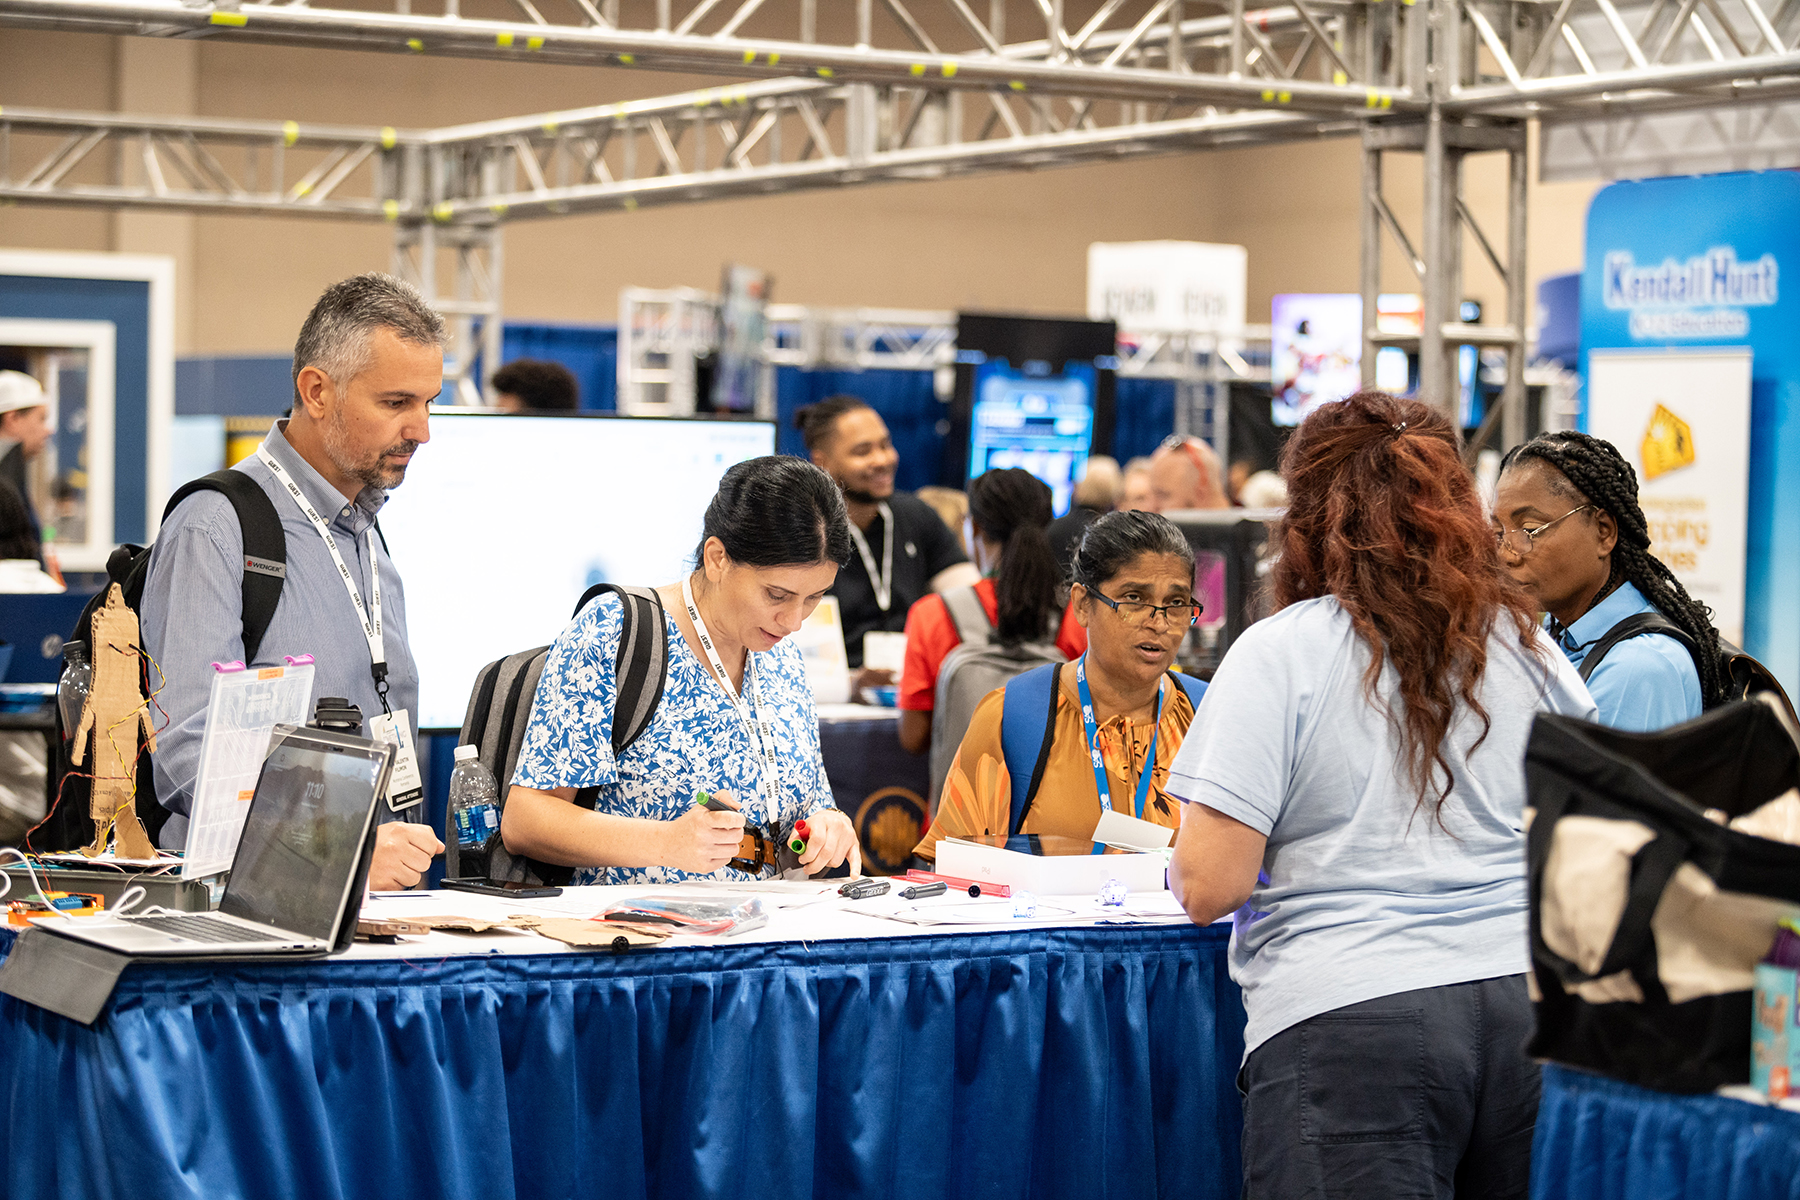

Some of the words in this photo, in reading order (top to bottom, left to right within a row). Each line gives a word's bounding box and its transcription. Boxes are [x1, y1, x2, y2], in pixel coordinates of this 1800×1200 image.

[1606, 254, 1704, 305] Kendall
[1708, 250, 1775, 304] Hunt
[267, 460, 281, 473] GUEST
[288, 483, 301, 497] GUEST
[307, 508, 320, 523] GUEST
[326, 535, 336, 550] GUEST
[252, 561, 281, 573] WENGER
[339, 563, 350, 579] GUEST
[353, 593, 362, 608] GUEST
[687, 606, 698, 621] GUEST
[365, 622, 373, 638] GUEST
[700, 634, 712, 650] GUEST
[715, 663, 726, 679] GUEST
[746, 719, 755, 735] GUEST
[761, 722, 770, 736] GUEST
[767, 749, 775, 764] GUEST
